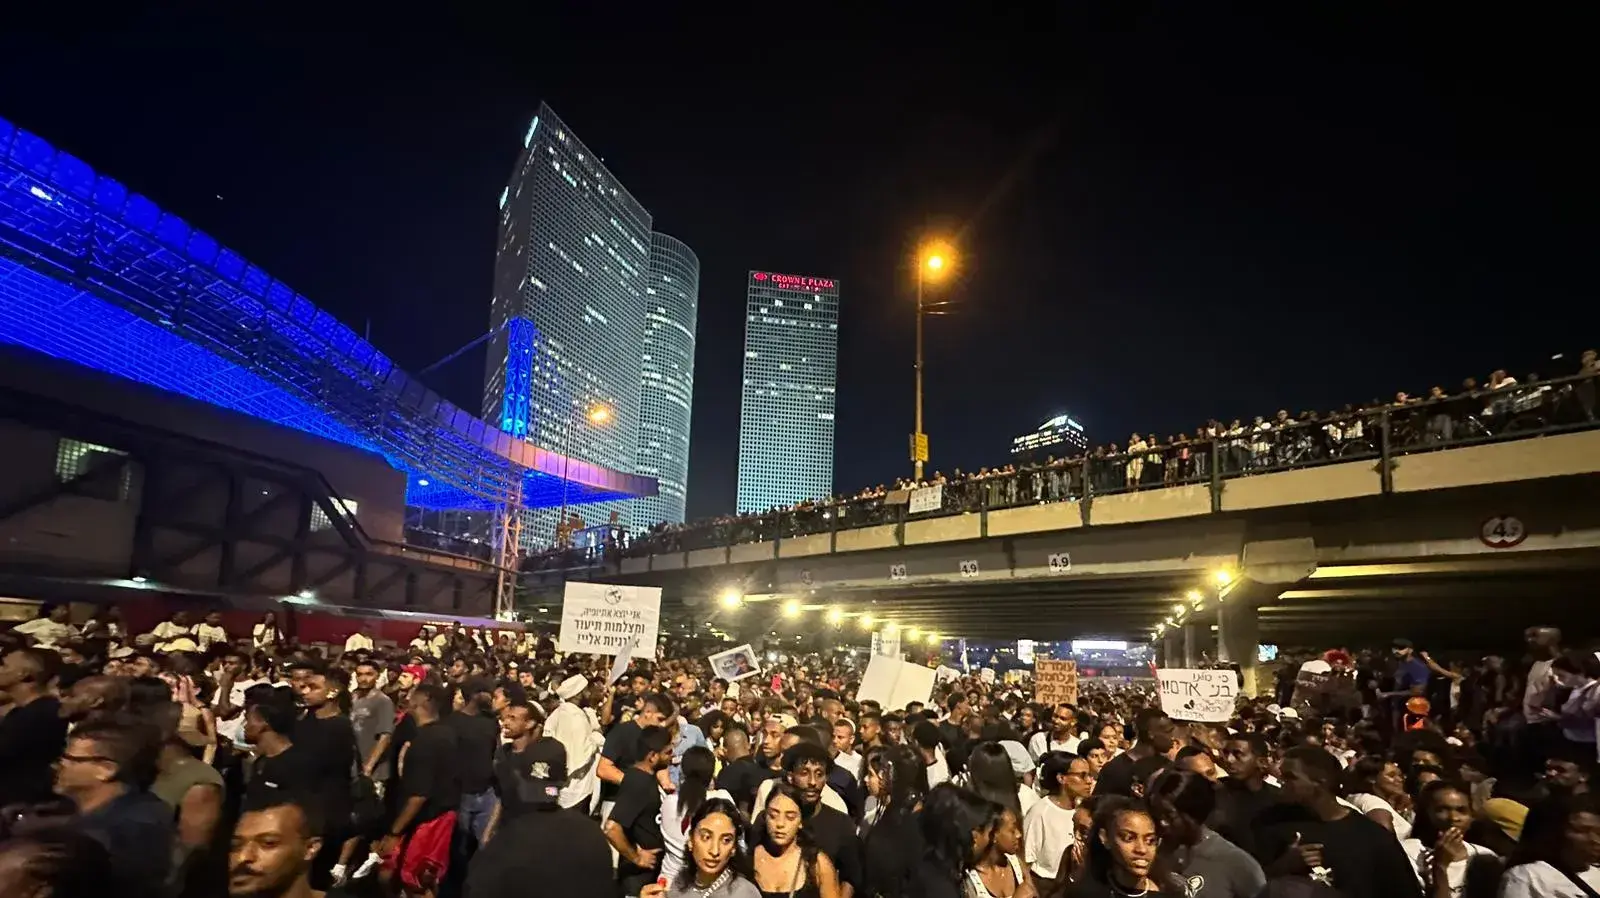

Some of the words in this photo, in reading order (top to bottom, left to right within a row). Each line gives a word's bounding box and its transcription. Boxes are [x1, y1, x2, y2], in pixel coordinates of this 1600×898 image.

[771, 274, 806, 285] CROWNE
[808, 278, 834, 288] PLAZA
[1051, 557, 1069, 567] 4.9
[892, 567, 906, 577] 4.9
[961, 564, 977, 574] 4.9
[580, 607, 612, 618] אתיופיה,
[613, 609, 629, 618] יוצא
[630, 610, 641, 619] אני
[574, 619, 602, 631] תיעוד
[604, 621, 645, 634] ומצלמות
[577, 632, 601, 645] אליי!
[1218, 674, 1229, 683] כי
[1162, 680, 1201, 696] אדם!!
[1209, 684, 1234, 697] בני
